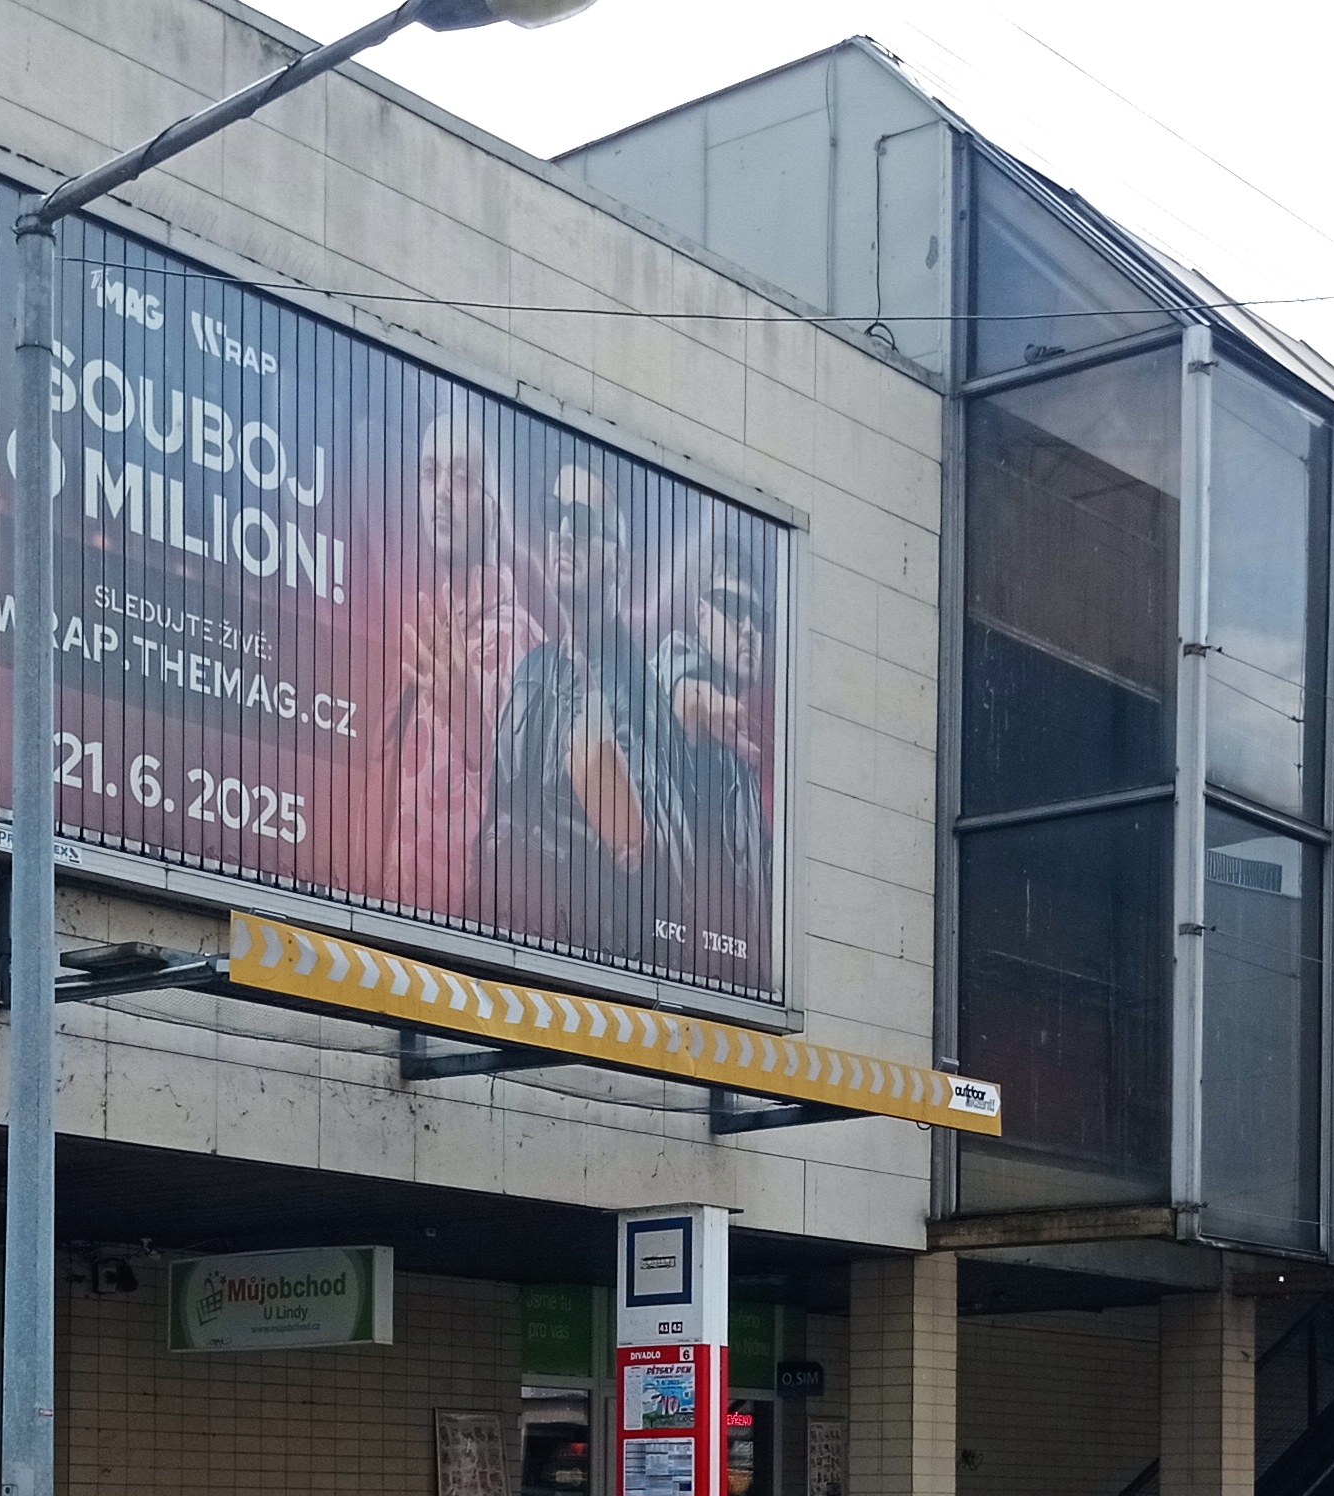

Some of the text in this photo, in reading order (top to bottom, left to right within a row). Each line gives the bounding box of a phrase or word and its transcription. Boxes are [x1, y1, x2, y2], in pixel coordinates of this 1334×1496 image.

[97, 279, 164, 330] MAG
[51, 340, 326, 508] SOUBOJ
[84, 447, 346, 605] MILION!
[94, 584, 215, 643] SLEDUJTE
[187, 768, 308, 845] 2025
[652, 919, 747, 960] KFC TIGER
[263, 1304, 309, 1322] U Lindy
[630, 1350, 662, 1361] DIVADLO
[796, 1371, 819, 1386] SIM
